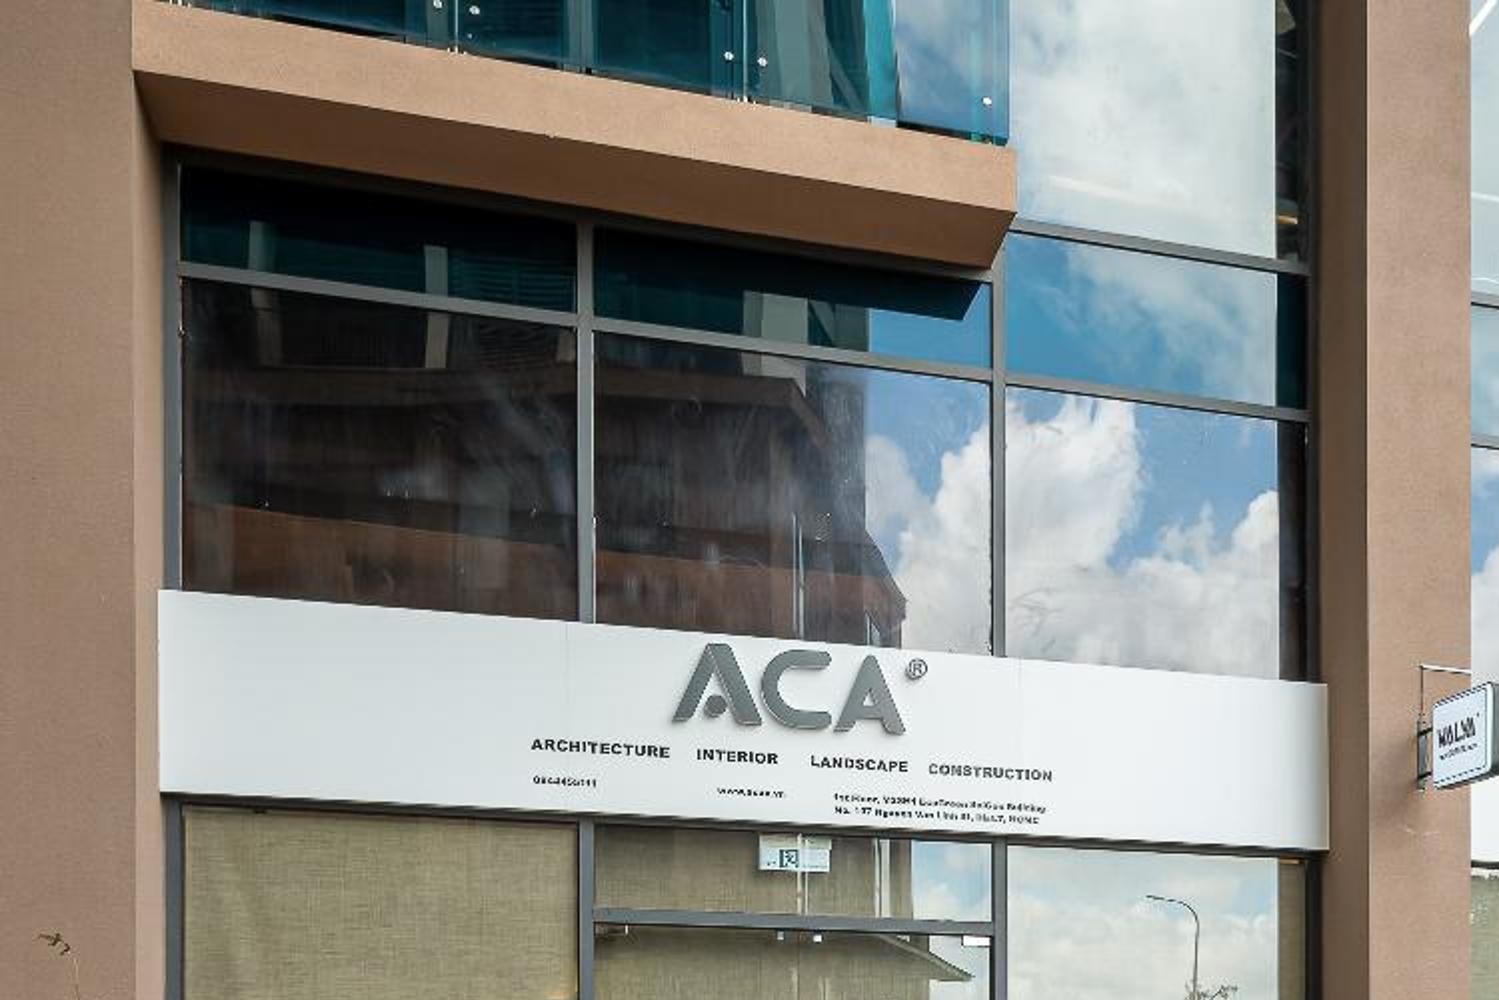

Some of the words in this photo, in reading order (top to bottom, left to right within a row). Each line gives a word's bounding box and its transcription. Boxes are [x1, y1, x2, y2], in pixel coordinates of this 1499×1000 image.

[673, 643, 906, 736] ACA
[1438, 716, 1476, 748] WALYA
[531, 738, 671, 759] ARCHITECTURE
[696, 748, 779, 765] INTERIOR
[810, 754, 909, 773] LANDSCAPE
[928, 763, 1053, 782] CONSTRUCTION
